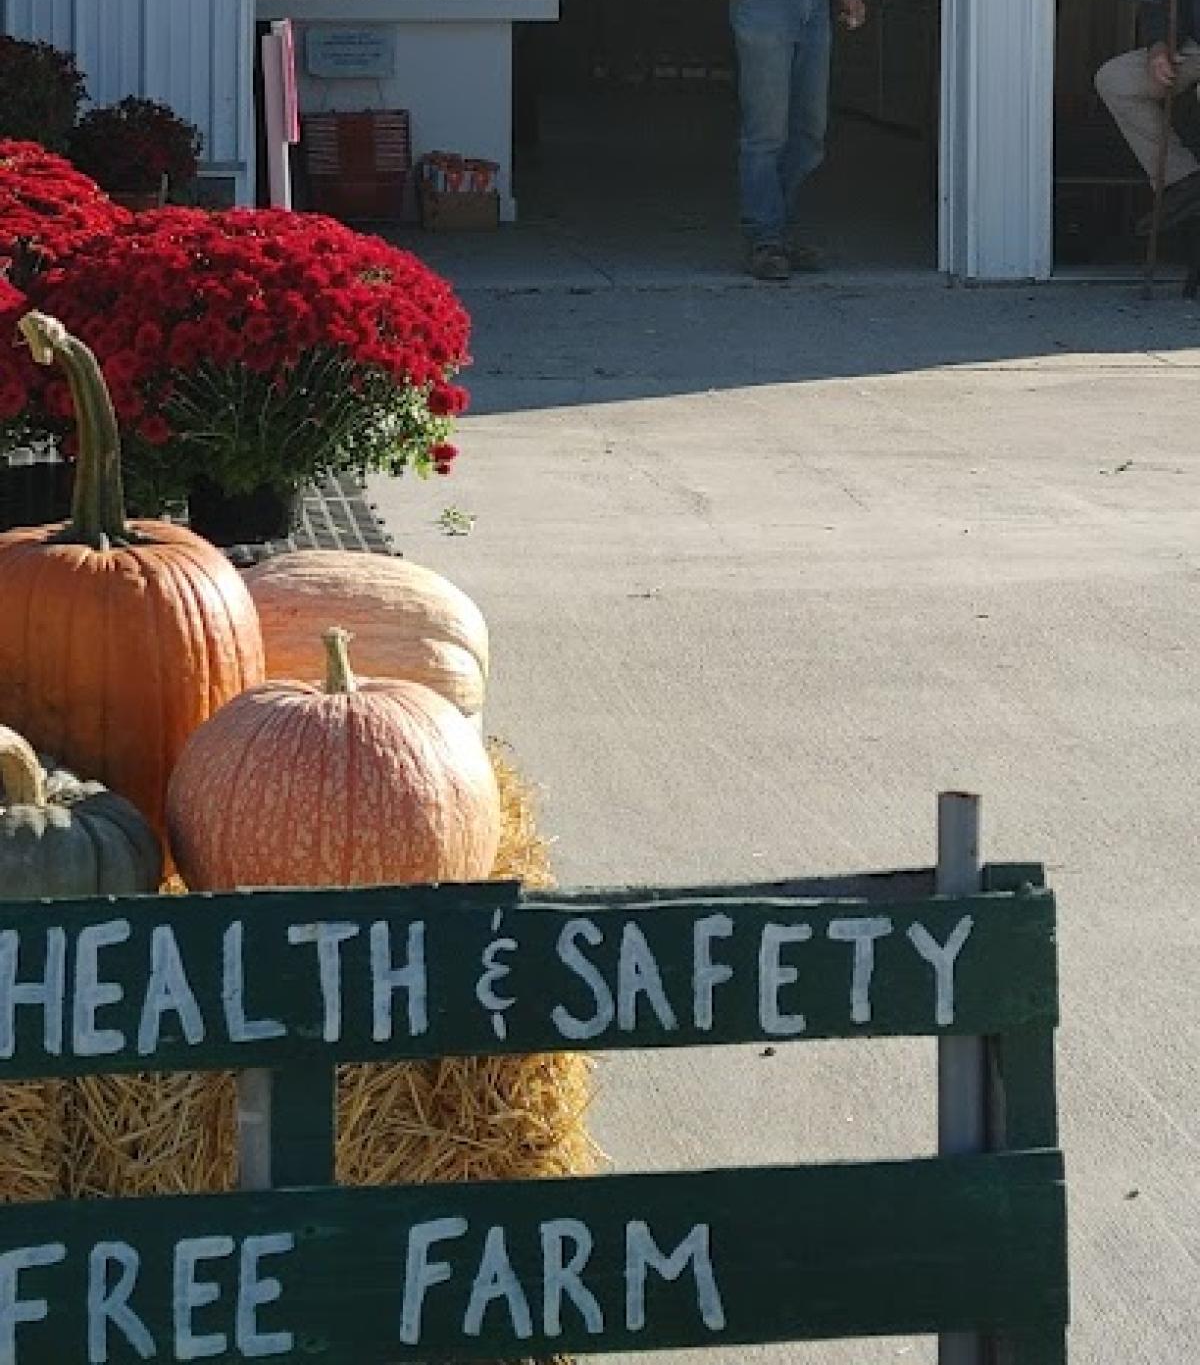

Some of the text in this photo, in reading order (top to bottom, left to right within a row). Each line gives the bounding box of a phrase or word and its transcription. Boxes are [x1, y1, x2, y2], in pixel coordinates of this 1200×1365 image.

[0, 907, 974, 1057] HEALTH & SAFETY
[0, 1217, 727, 1363] FREE FARM
